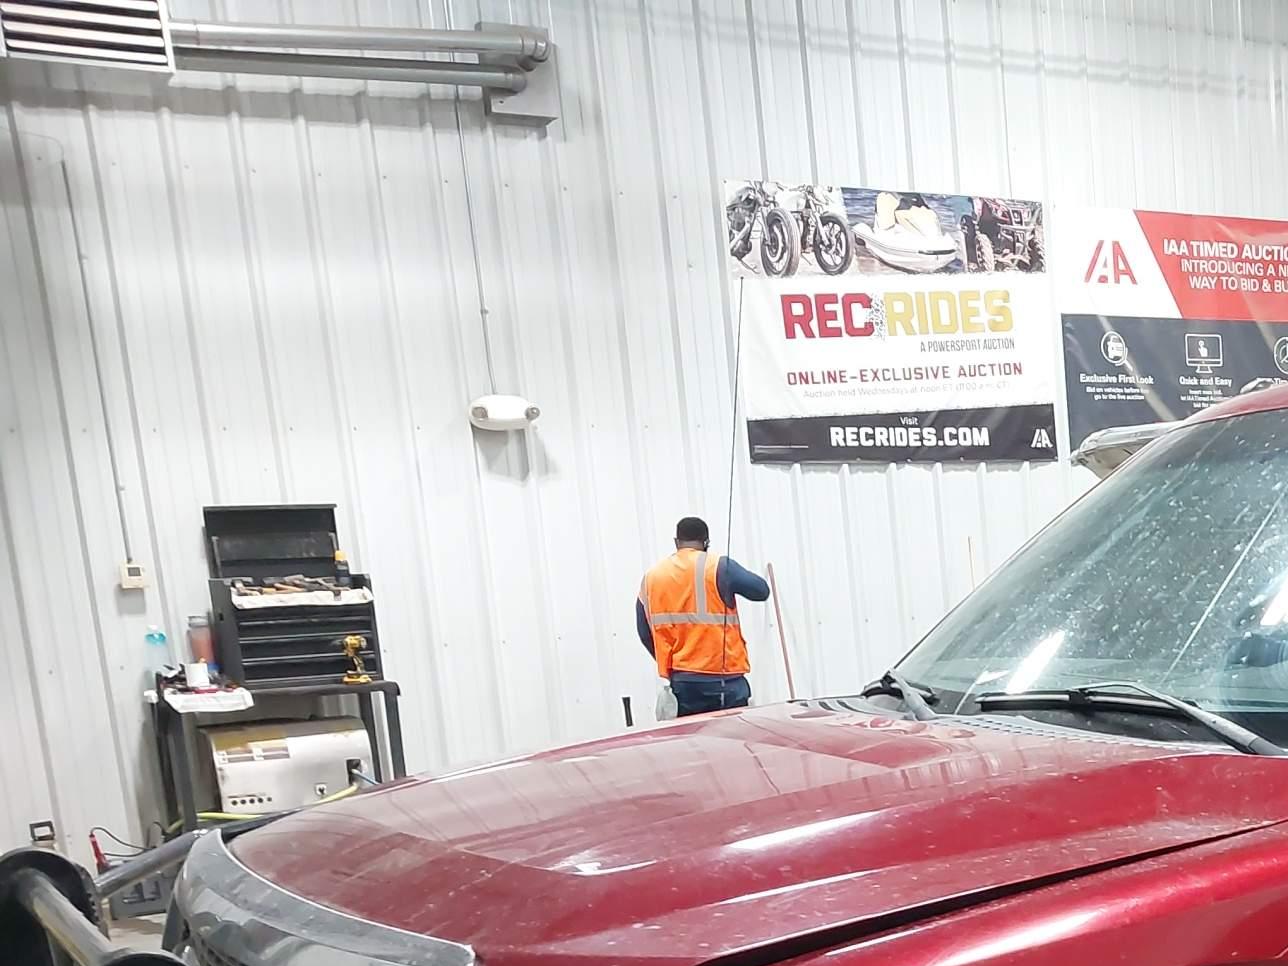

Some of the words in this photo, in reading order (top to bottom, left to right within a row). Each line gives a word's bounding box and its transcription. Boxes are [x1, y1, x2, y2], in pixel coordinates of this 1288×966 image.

[1163, 238, 1189, 257] IAA
[1190, 240, 1238, 260] TIMED
[1181, 259, 1264, 276] INTRODUCING
[1266, 264, 1276, 277] A
[1189, 276, 1217, 290] WAY
[1218, 277, 1238, 291] TO
[1240, 278, 1260, 292] BID
[1262, 279, 1272, 292] &
[780, 292, 875, 340] REC
[883, 290, 1015, 337] RIDES
[920, 342, 927, 353] A
[928, 340, 982, 352] POWERSPORT
[983, 338, 1015, 351] AUCTION
[787, 365, 951, 386] ONLINE-EXCLUSIVE
[957, 362, 1023, 379] AUCTION
[1079, 373, 1117, 384] Exclusive
[1118, 374, 1135, 384] First
[1136, 375, 1154, 385] Look
[1179, 376, 1199, 386] Quick
[1199, 377, 1213, 386] and
[1215, 377, 1233, 388] Easy
[803, 387, 835, 398] Auction
[899, 416, 919, 426] Visit
[829, 427, 991, 447] RECRIDES.COM
